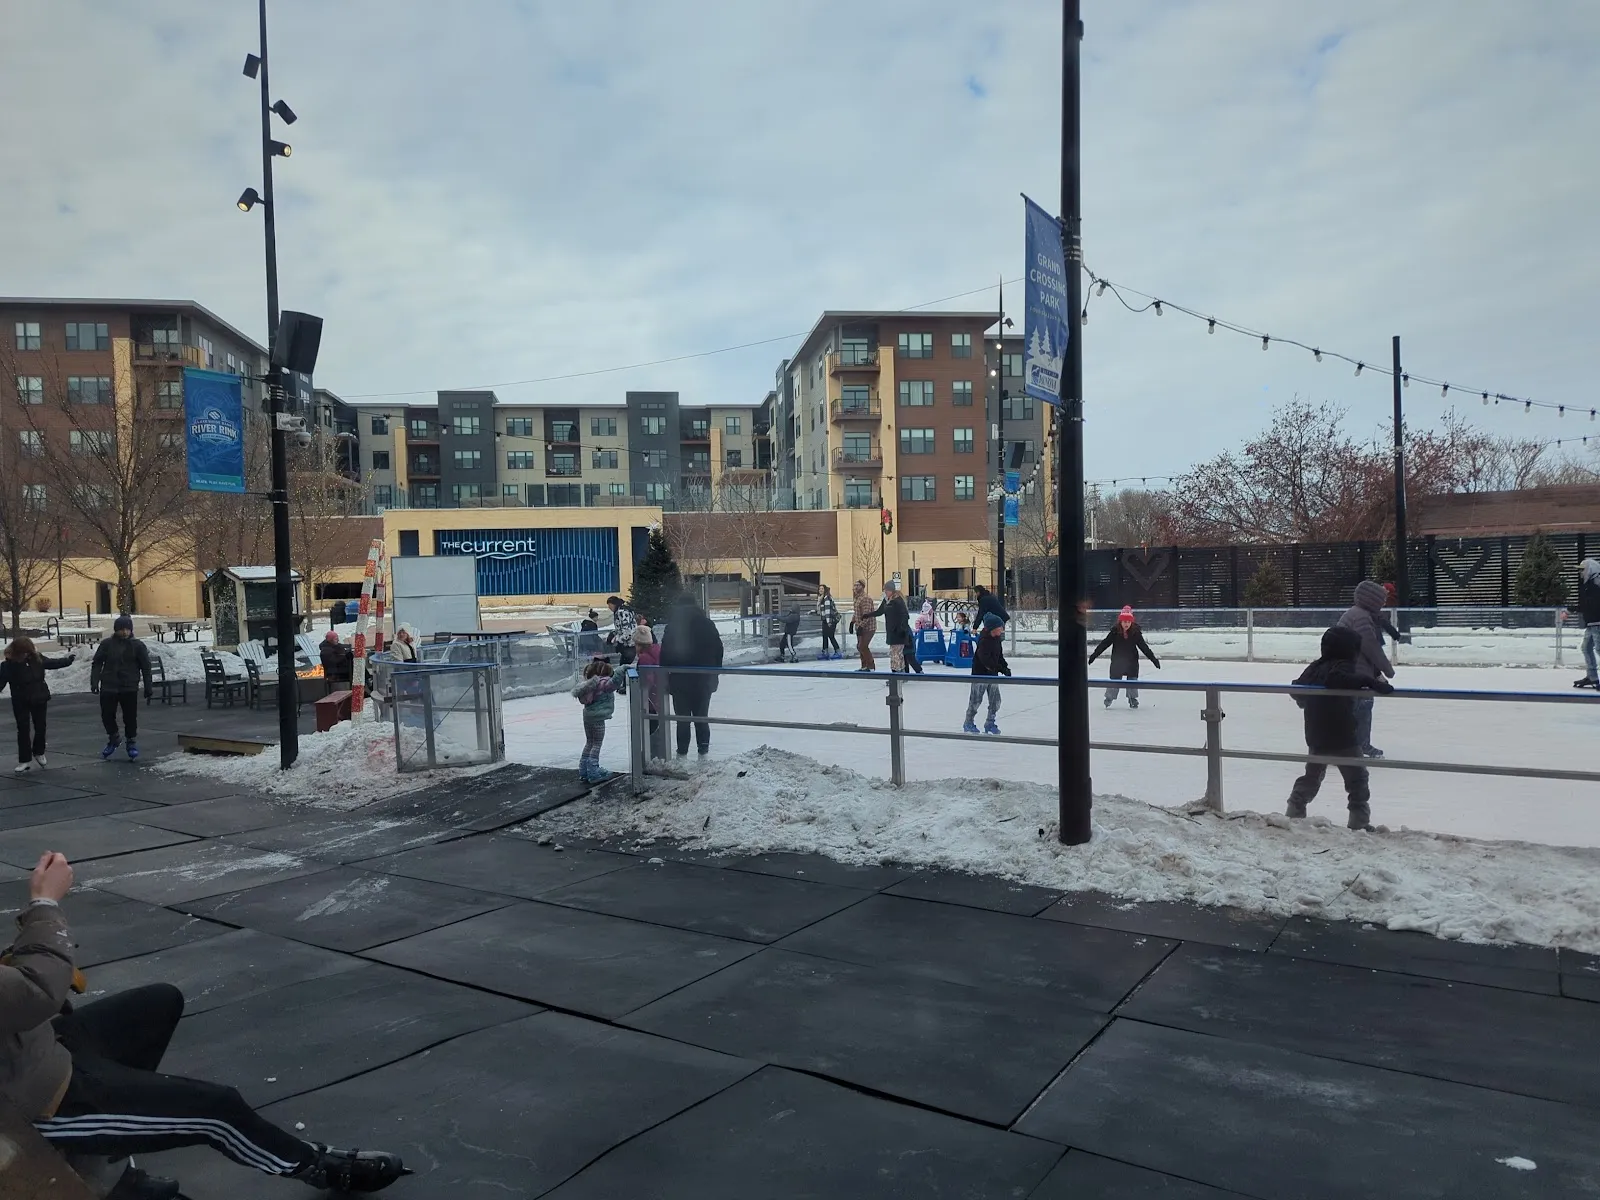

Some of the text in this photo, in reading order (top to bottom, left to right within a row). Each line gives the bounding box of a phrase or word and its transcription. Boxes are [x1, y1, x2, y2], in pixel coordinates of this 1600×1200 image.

[1037, 253, 1061, 276] GRAND
[1040, 291, 1060, 311] PARK
[191, 424, 217, 434] RIVER
[219, 425, 237, 438] RINK
[441, 537, 536, 553] THE current
